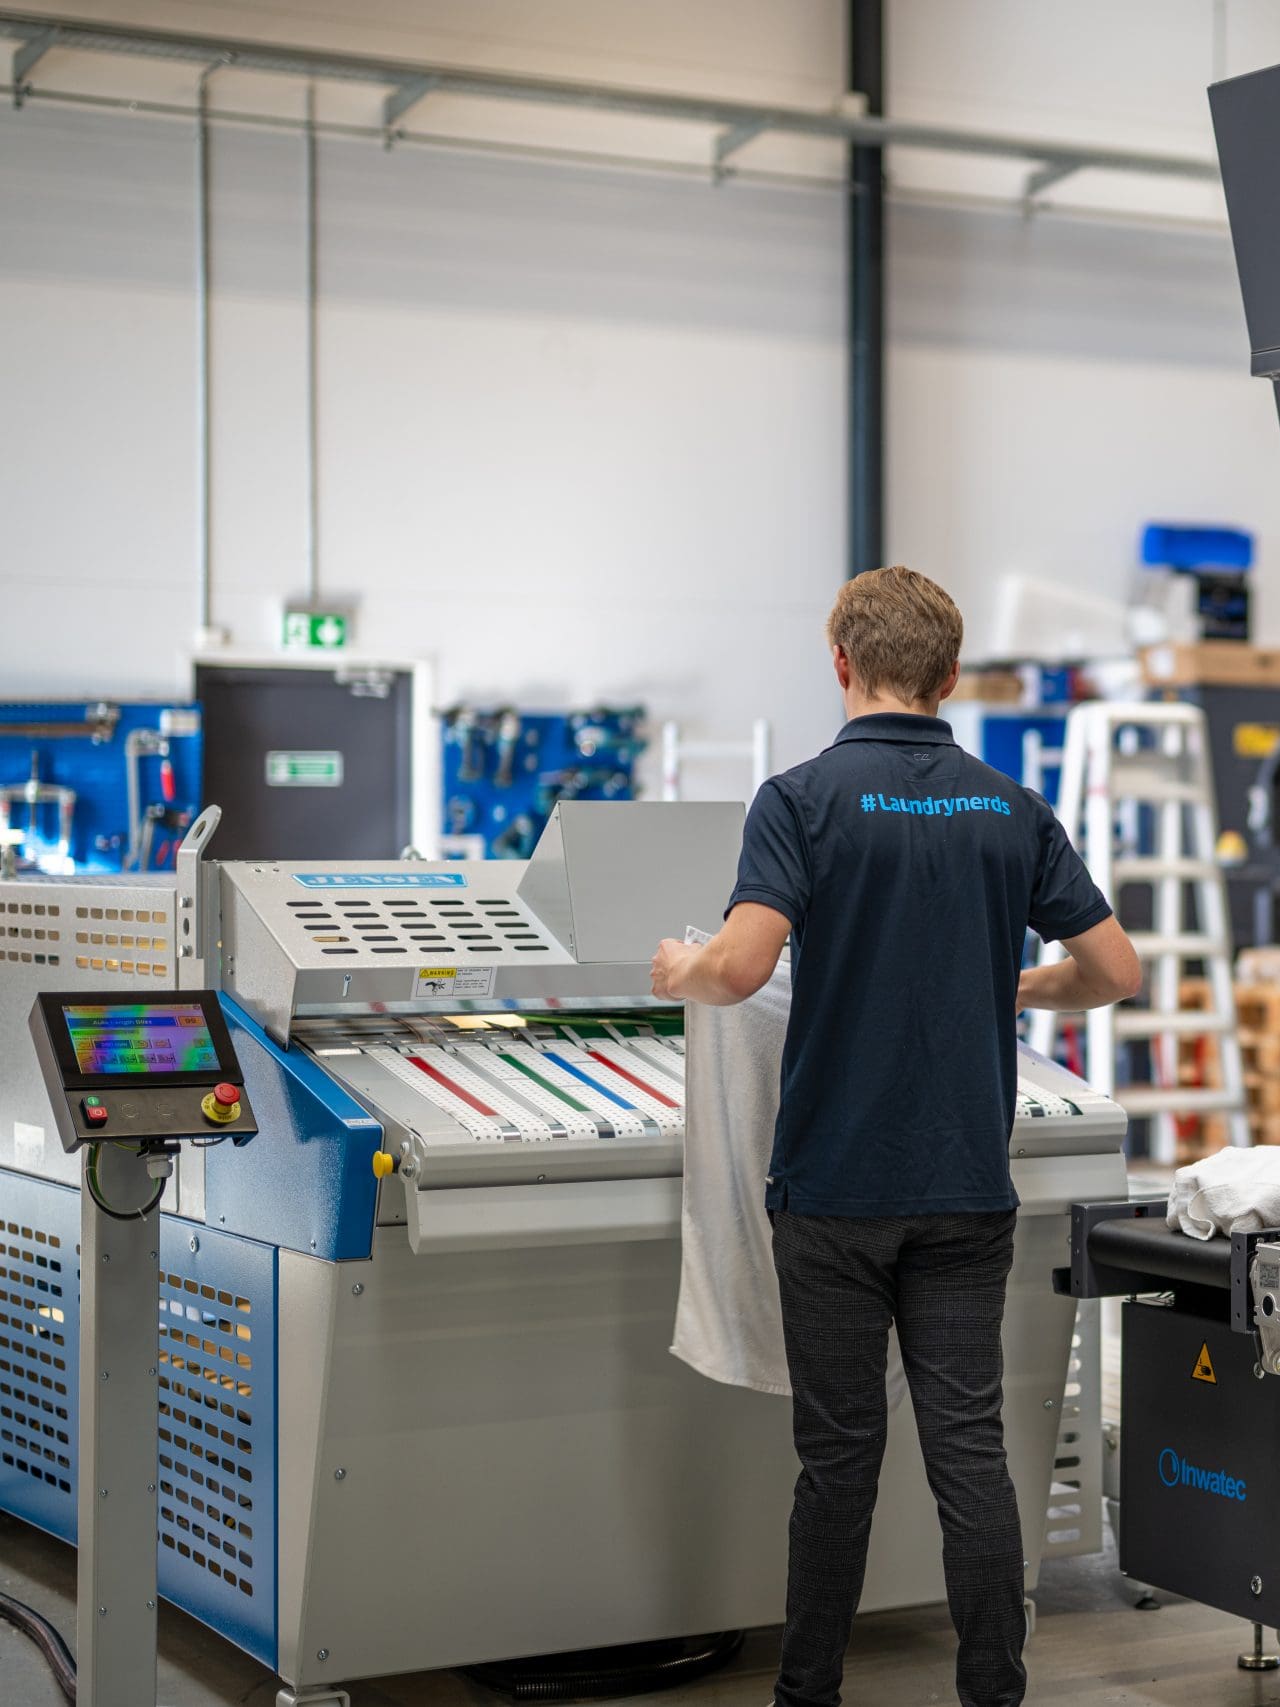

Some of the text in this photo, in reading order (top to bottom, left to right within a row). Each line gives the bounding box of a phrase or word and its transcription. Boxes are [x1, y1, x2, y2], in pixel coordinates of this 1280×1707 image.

[860, 793, 1011, 817] #Laundrynerds
[307, 876, 456, 884] JENSEN
[1181, 1457, 1247, 1502] Inwatec
